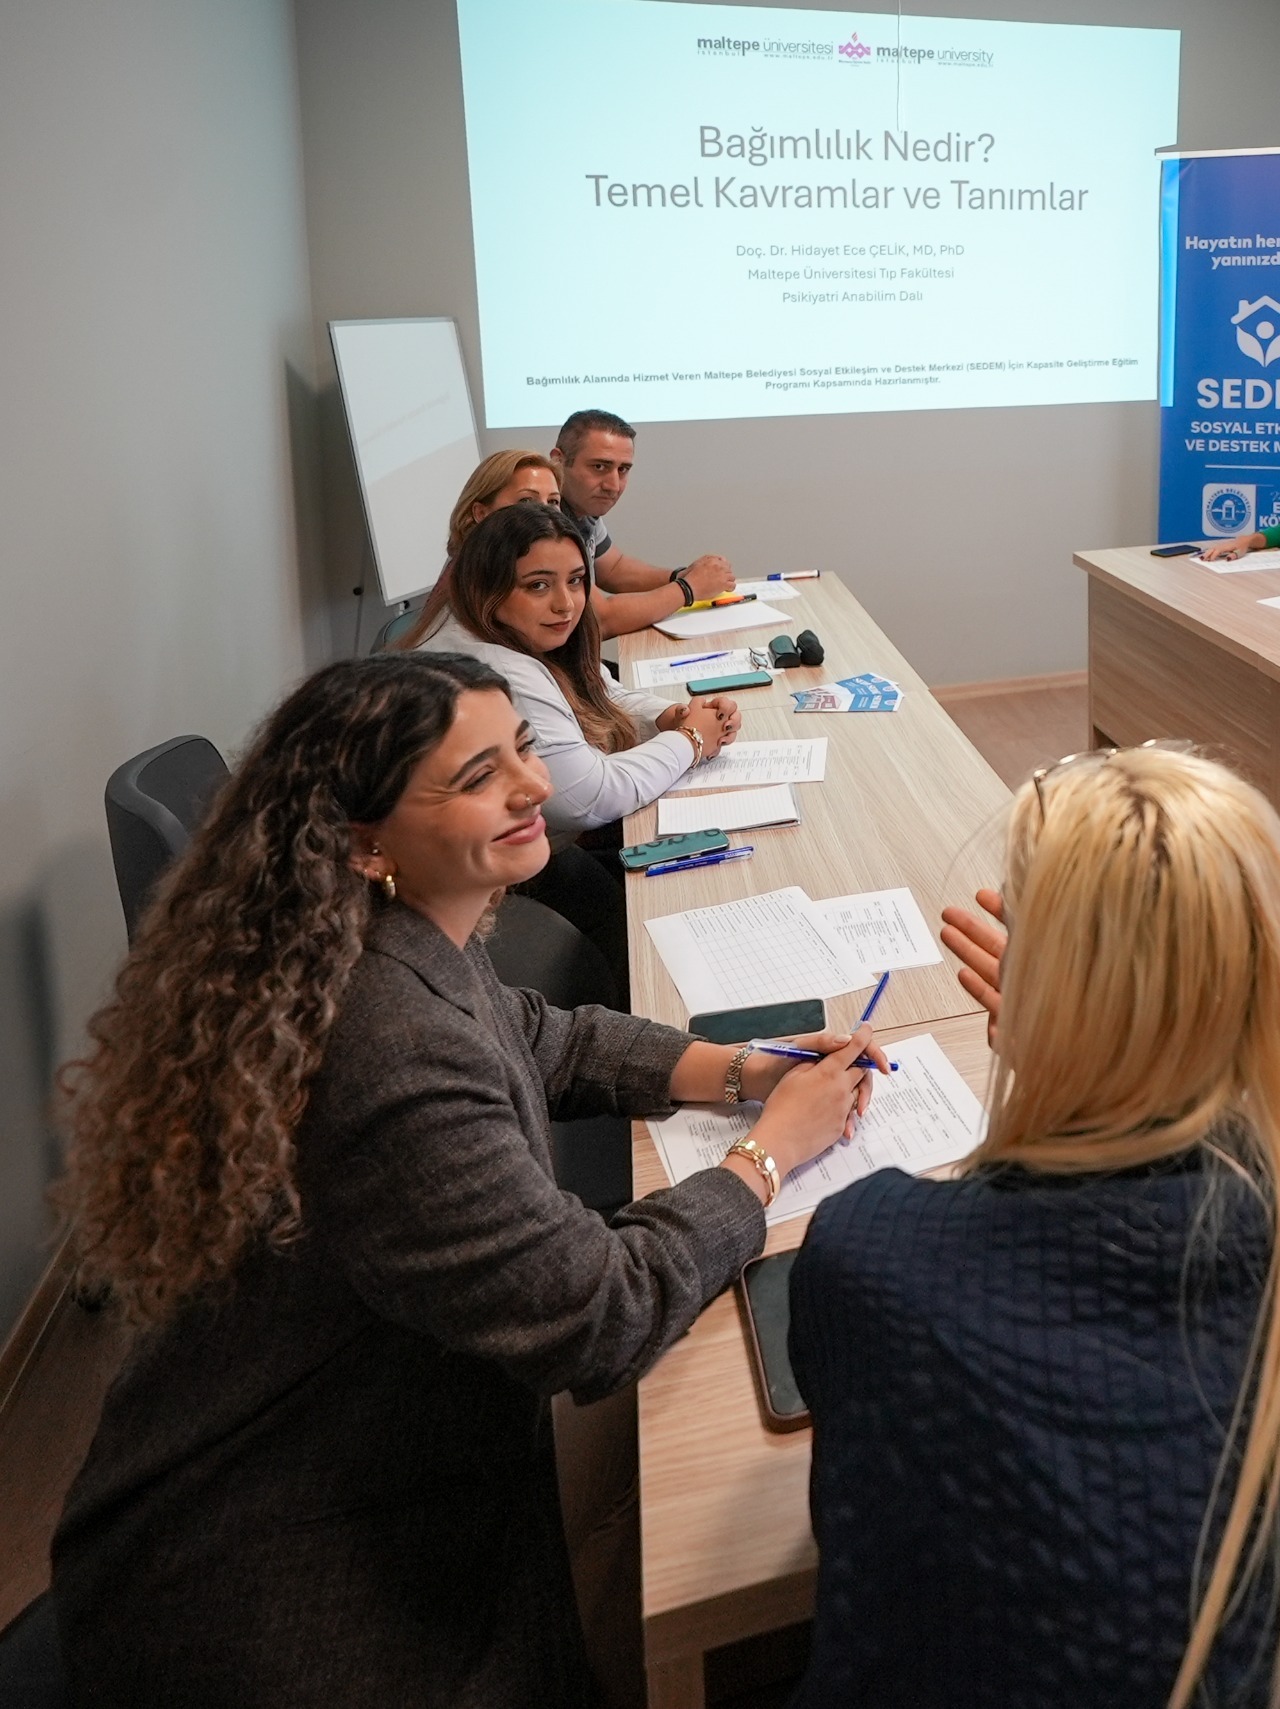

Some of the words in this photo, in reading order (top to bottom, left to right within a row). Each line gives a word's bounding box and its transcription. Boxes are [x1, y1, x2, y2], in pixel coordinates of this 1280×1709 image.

[697, 36, 760, 56] maltepe
[763, 37, 834, 55] üniversitesi
[876, 46, 934, 64] maltepe
[937, 47, 994, 64] university
[699, 125, 873, 166] Bağımlılık
[883, 130, 996, 163] Nedir?
[585, 174, 704, 208] Temel
[714, 176, 895, 210] Kavramlar
[902, 185, 941, 210] ve
[950, 179, 1089, 212] Tanımlar
[736, 244, 766, 259] Doç.
[770, 244, 788, 257] Dr.
[791, 243, 840, 259] Hidayet
[843, 244, 866, 256] Ece
[869, 241, 909, 259] ÇELİK,
[913, 244, 937, 258] MD,
[940, 243, 965, 256] PhD
[1185, 235, 1252, 251] Hayatın
[748, 268, 800, 282] Maltepe
[804, 265, 876, 280] Üniversitesi
[880, 267, 897, 282] Tıp
[900, 266, 955, 280] Fakültesi
[782, 290, 839, 304] Psikiyatri
[841, 290, 896, 302] Anabilim
[900, 290, 923, 302] Dalı
[526, 375, 581, 387] Bağımlılık
[583, 374, 630, 384] Alanında
[633, 373, 669, 382] Hizmet
[672, 371, 701, 381] Veren
[704, 370, 743, 381] Maltepe
[746, 368, 797, 379] Belediyesi
[800, 367, 832, 378] Sosyal
[835, 365, 878, 376] Etkileşim
[894, 364, 926, 373] Destek
[929, 363, 964, 372] Merkezi
[966, 361, 1006, 372] (SEDEM)
[1008, 360, 1025, 371] İçin
[1026, 360, 1064, 371] Kapasite
[1066, 358, 1110, 369] Geliştirme
[1112, 357, 1139, 368] Eğitim
[765, 380, 811, 391] Programı
[813, 378, 873, 389] Kapsamında
[874, 375, 941, 387] Hazırlanmıştır.
[1190, 421, 1252, 436] SOSYAL
[1185, 439, 1205, 453] VE
[1208, 439, 1271, 454] DESTEK
